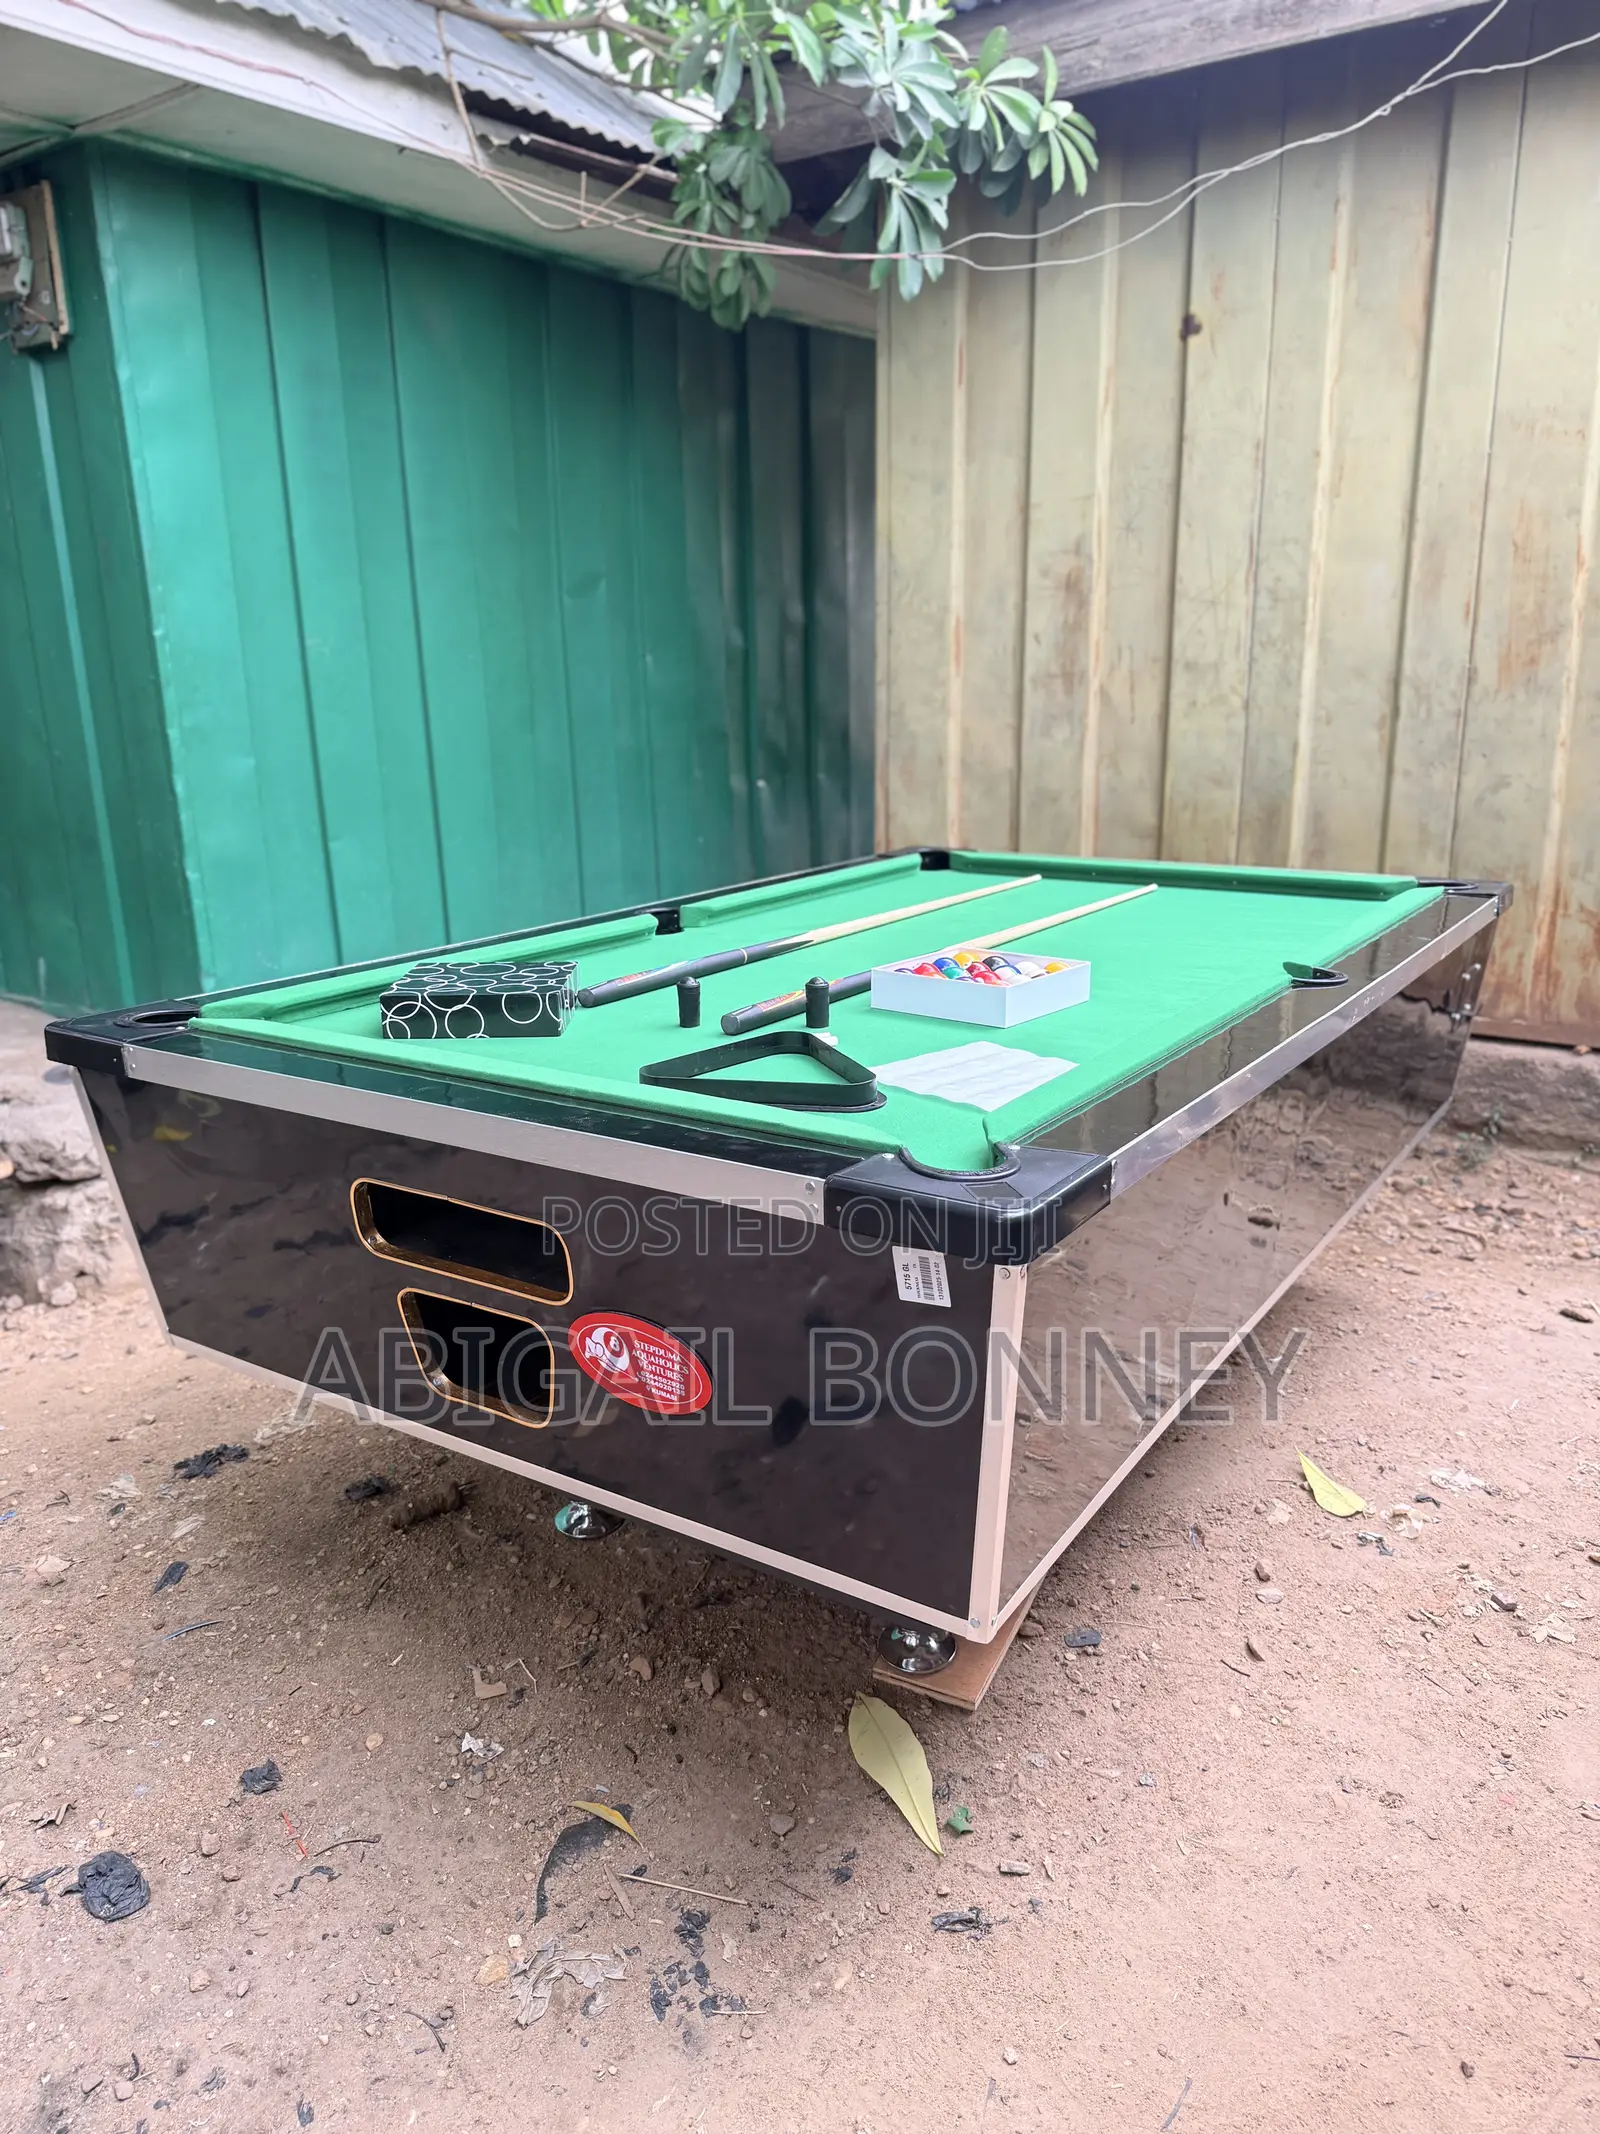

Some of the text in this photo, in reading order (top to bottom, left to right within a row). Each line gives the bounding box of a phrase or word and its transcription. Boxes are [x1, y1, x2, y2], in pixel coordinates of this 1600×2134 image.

[903, 1273, 912, 1290] 5715
[632, 1349, 689, 1375] AQUAHOLICS
[634, 1340, 682, 1363] STEPDUMA
[638, 1358, 684, 1383] VENTURES
[651, 1387, 678, 1402] KUMASI
